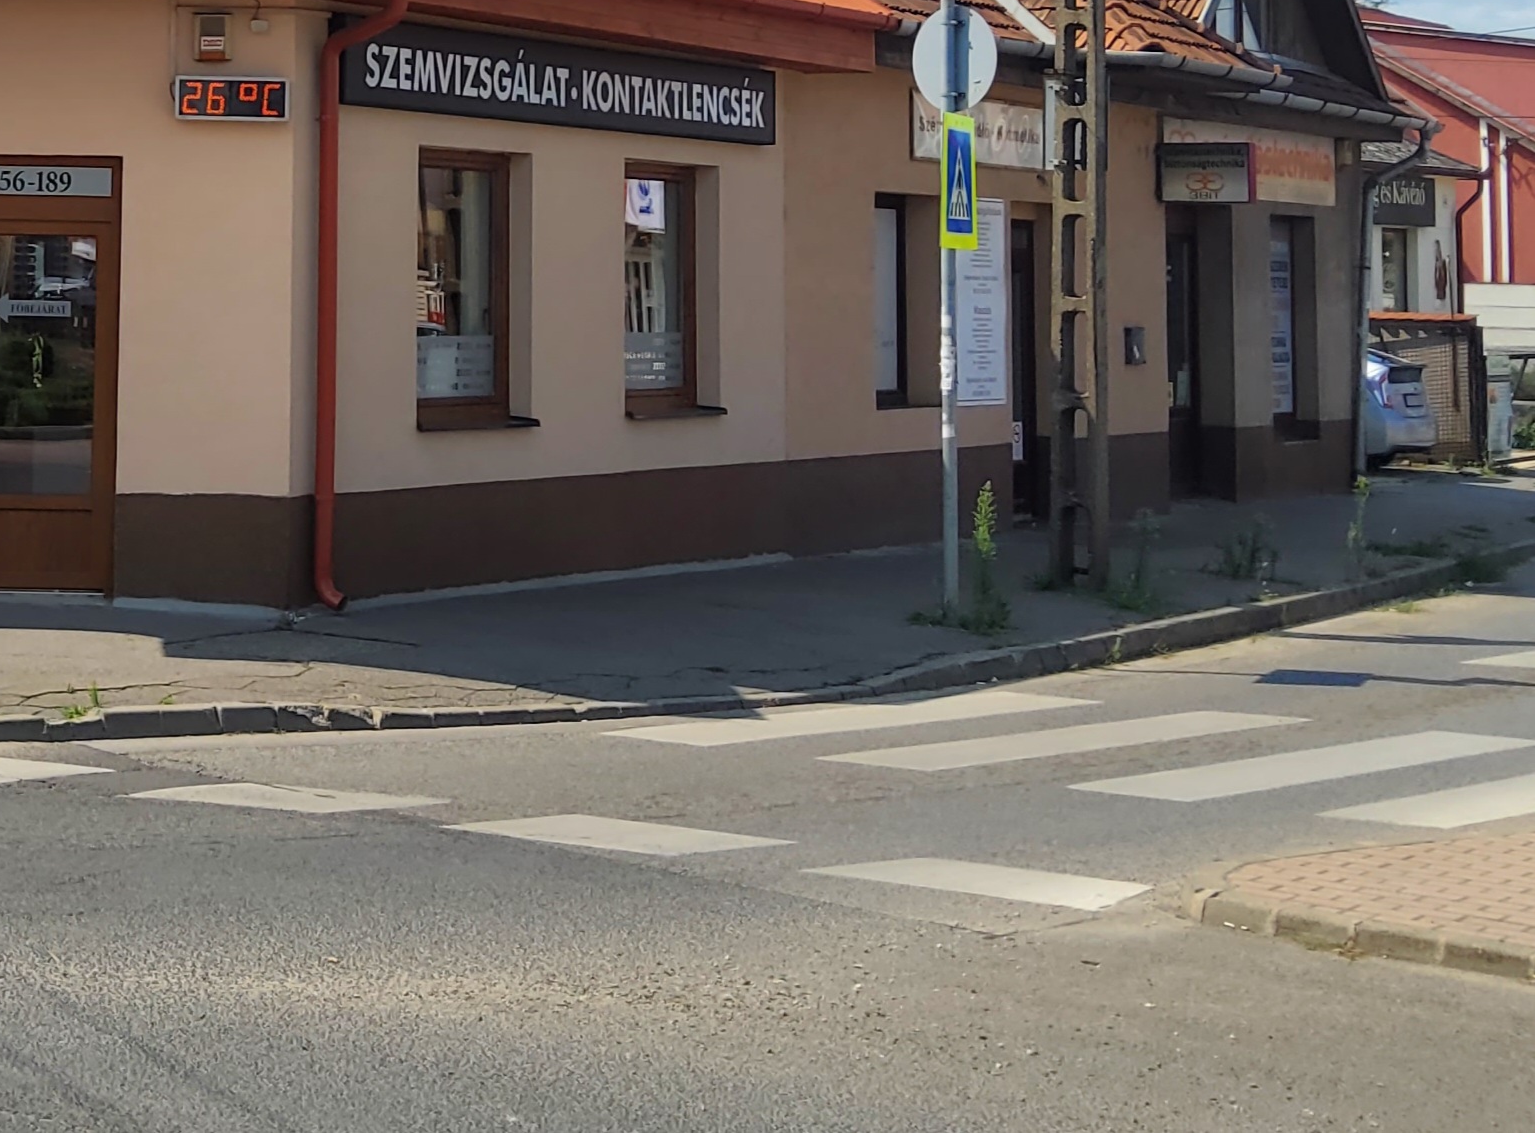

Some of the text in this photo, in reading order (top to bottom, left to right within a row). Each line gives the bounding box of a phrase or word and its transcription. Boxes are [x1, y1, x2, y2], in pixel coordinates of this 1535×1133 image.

[182, 81, 281, 116] 26 °C
[365, 42, 765, 128] SZEMVIZSGÁLAT KONTAKTLENCSÉK
